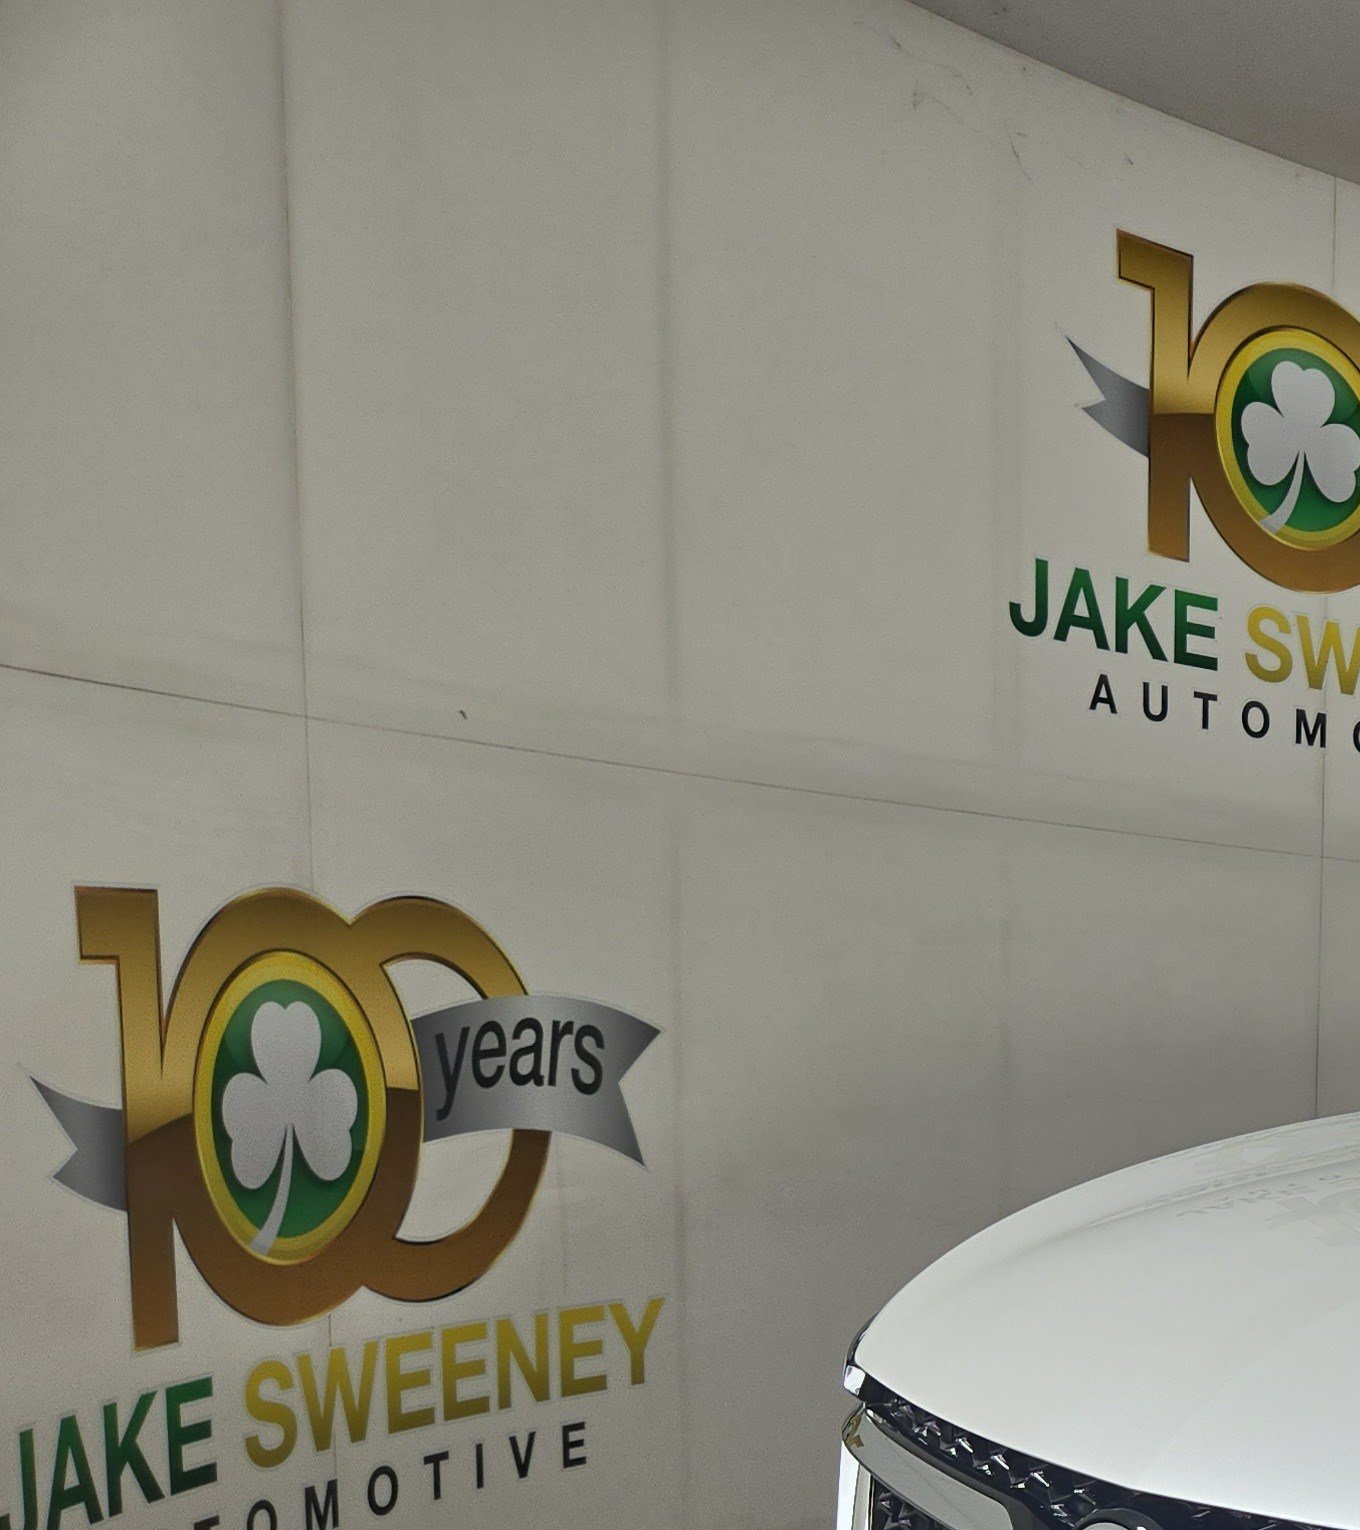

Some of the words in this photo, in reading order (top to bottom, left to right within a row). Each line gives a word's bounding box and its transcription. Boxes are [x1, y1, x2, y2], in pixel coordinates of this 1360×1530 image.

[1008, 557, 1219, 671] JAKE
[433, 1016, 606, 1122] years
[243, 1296, 666, 1469] SWEENEY
